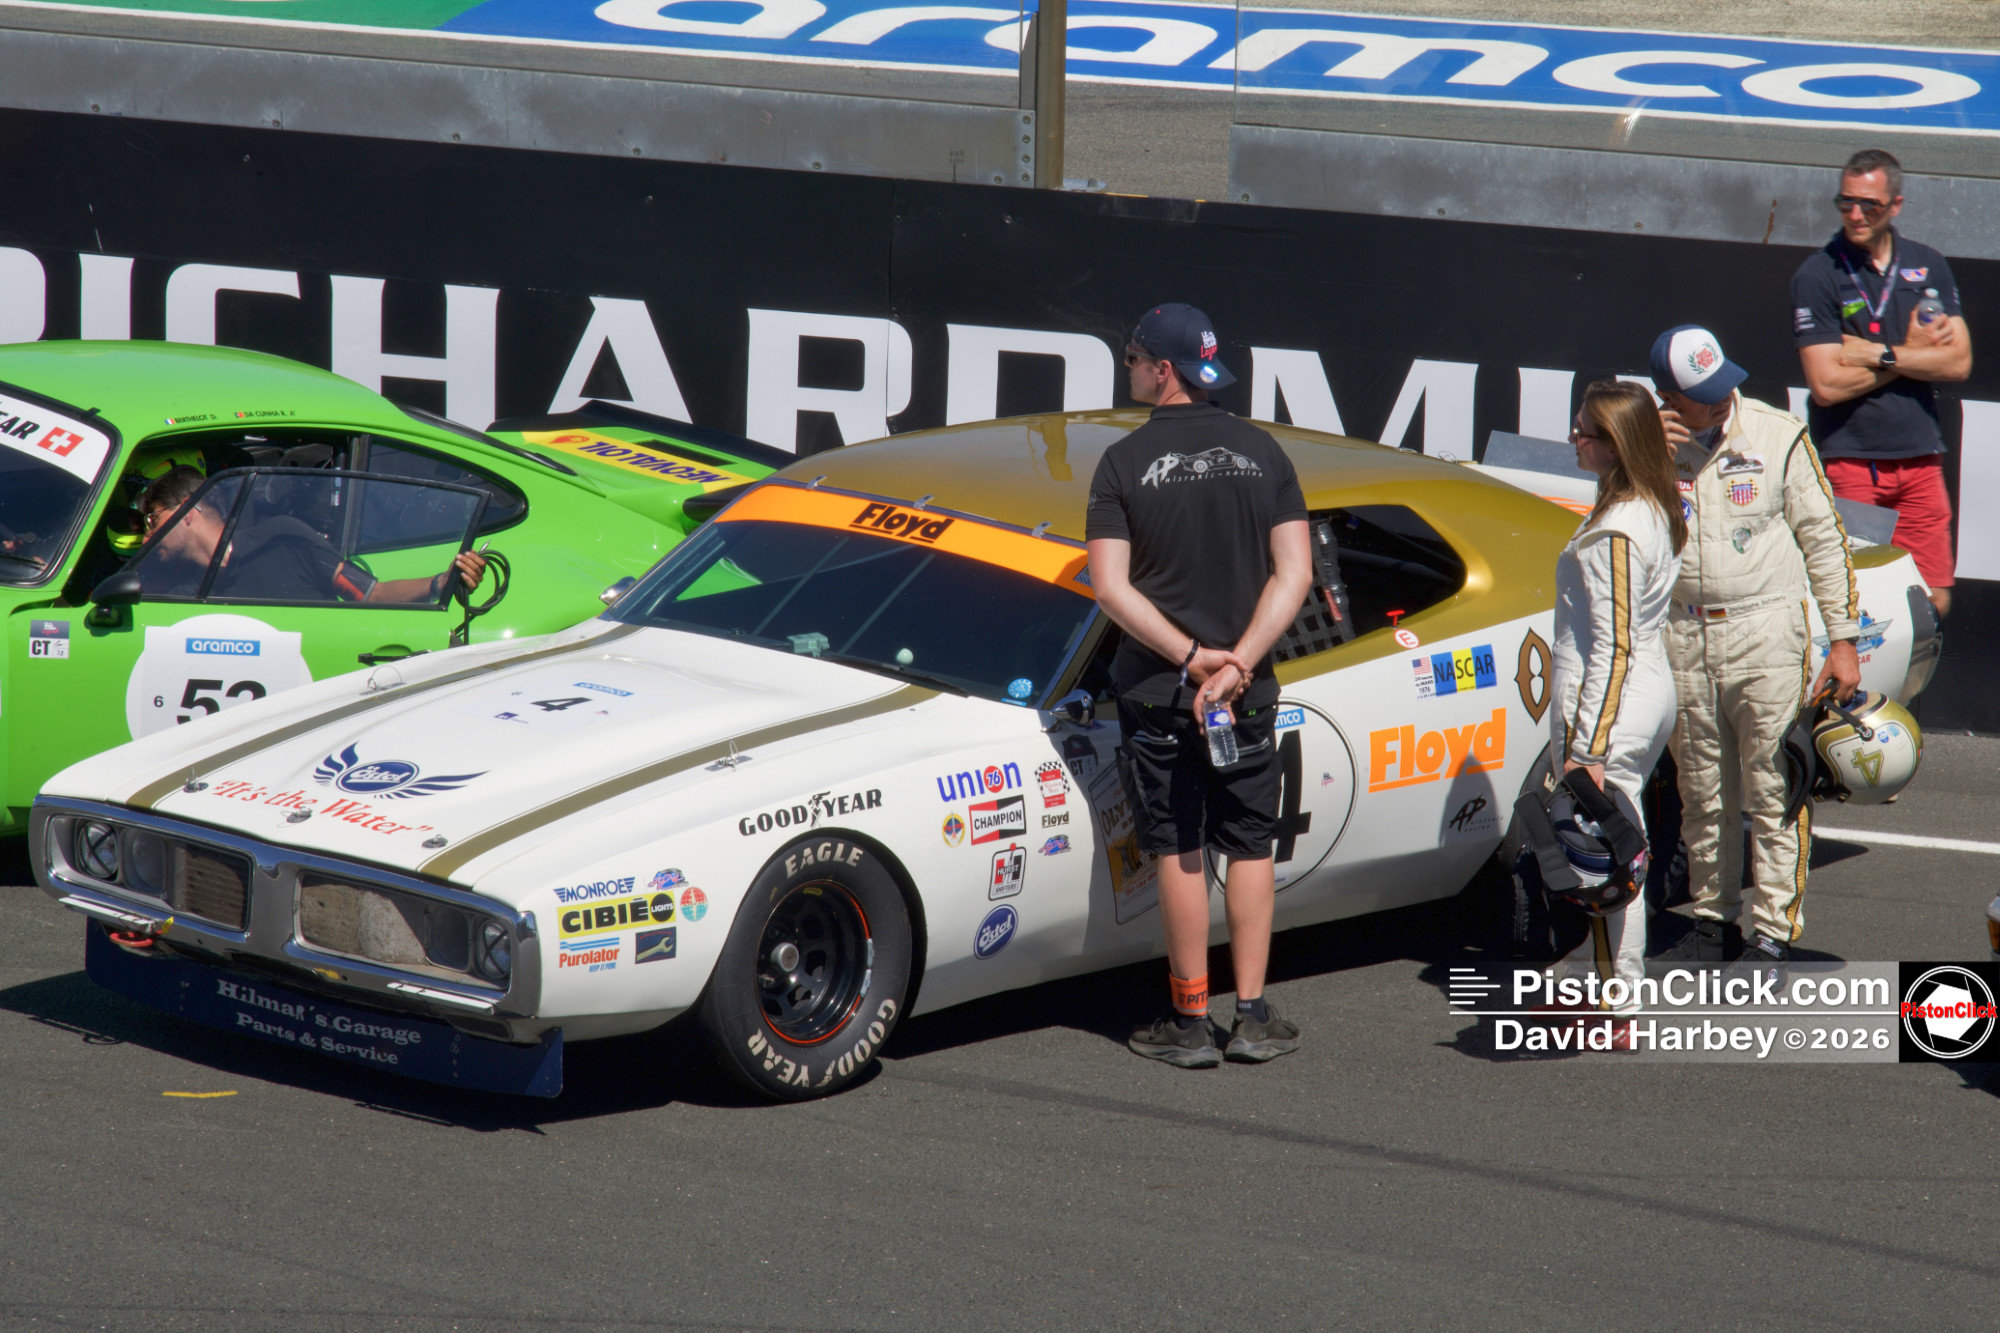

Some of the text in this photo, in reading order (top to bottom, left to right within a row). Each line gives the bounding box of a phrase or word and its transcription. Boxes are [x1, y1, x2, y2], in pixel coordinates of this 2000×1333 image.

[577, 441, 633, 458] OIL
[849, 503, 955, 544] Floyd
[31, 640, 51, 656] CT
[192, 640, 254, 654] aramco
[1434, 653, 1495, 685] NASCAR
[1418, 686, 1431, 694] 1976
[154, 696, 164, 707] 6
[531, 696, 593, 712] 4
[1369, 707, 1506, 785] Floyd
[263, 790, 319, 810] the
[973, 809, 1022, 831] CHAMPION
[1041, 811, 1069, 828] Floyd
[785, 842, 864, 879] EAGLE
[997, 864, 1019, 876] HURST
[567, 879, 628, 902] MONROE
[651, 903, 674, 913] LIGHTS
[559, 948, 620, 968] Purolator
[236, 1011, 399, 1065] Parts & Service
[333, 1016, 422, 1045] Garage
